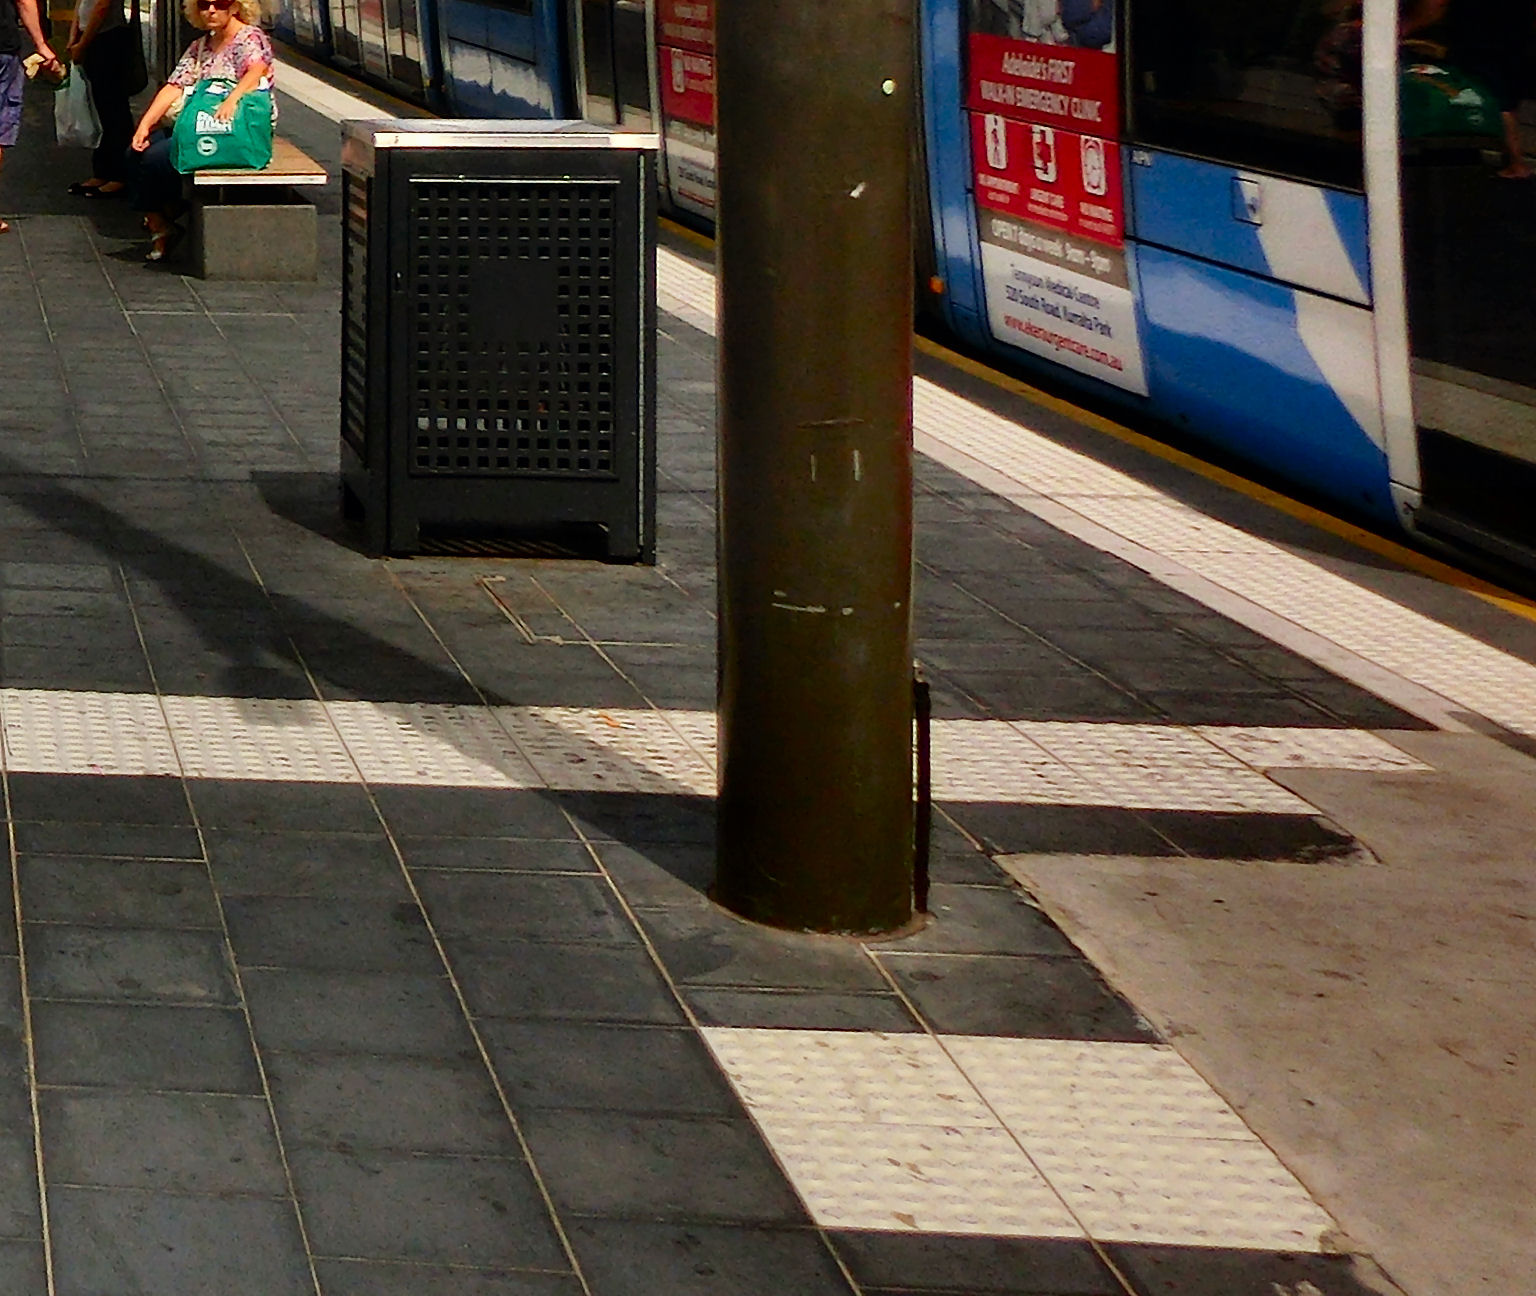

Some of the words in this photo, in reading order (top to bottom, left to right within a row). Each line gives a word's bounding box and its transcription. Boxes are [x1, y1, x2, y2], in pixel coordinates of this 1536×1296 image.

[1048, 58, 1075, 84] FIRST
[1015, 86, 1068, 116] EMERGENCY
[1071, 97, 1102, 122] CLINIC
